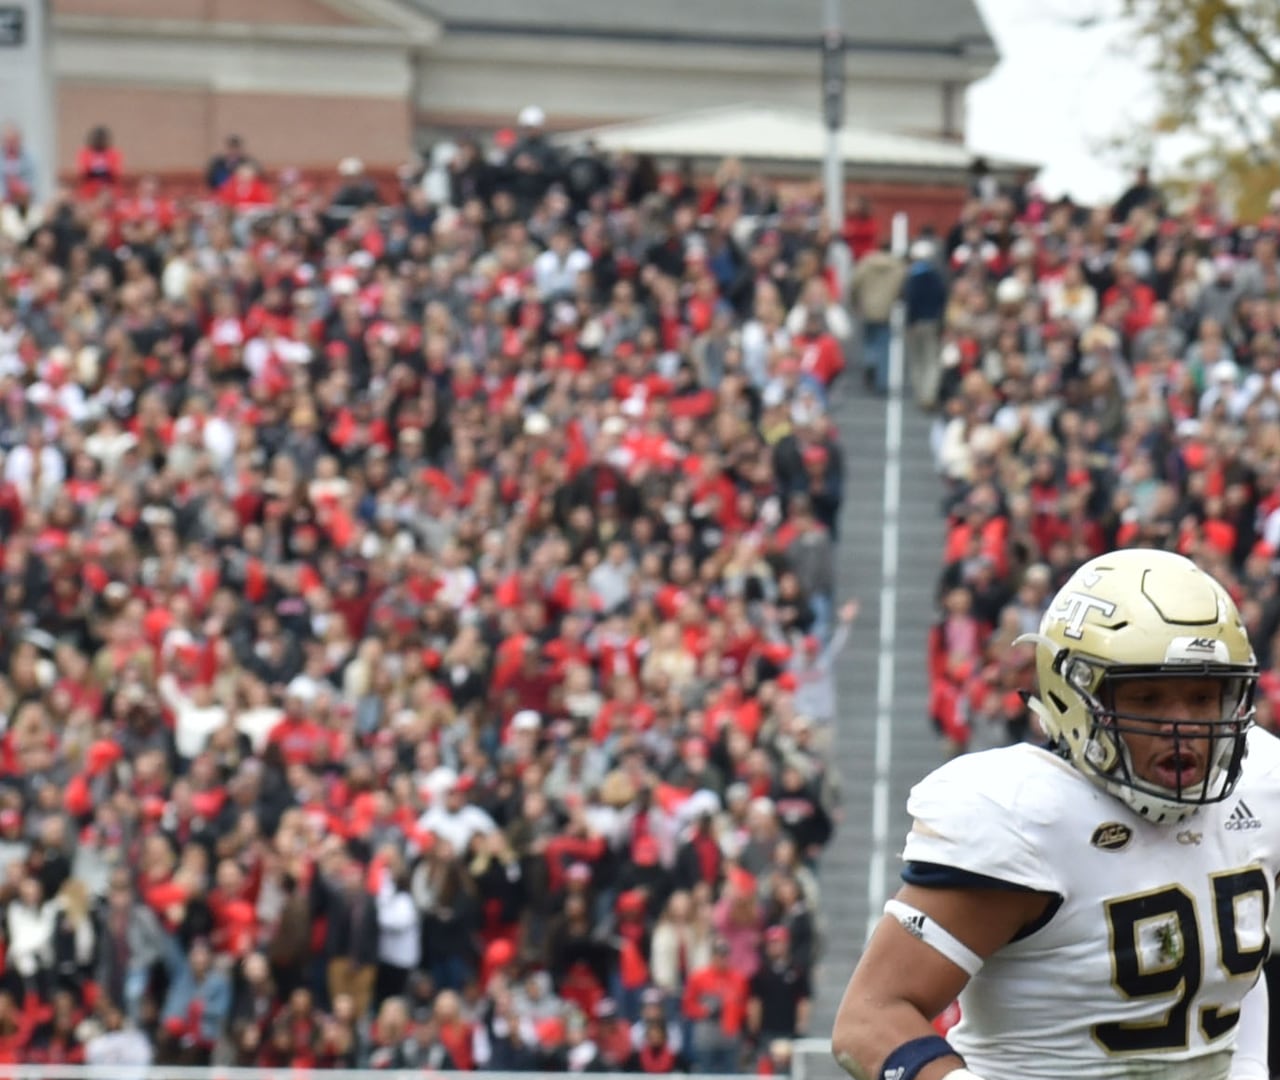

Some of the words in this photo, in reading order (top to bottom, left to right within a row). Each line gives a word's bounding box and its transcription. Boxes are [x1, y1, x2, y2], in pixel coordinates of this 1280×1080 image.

[1188, 638, 1217, 649] ACC
[1224, 820, 1262, 831] adidas
[1089, 862, 1271, 1058] 99
